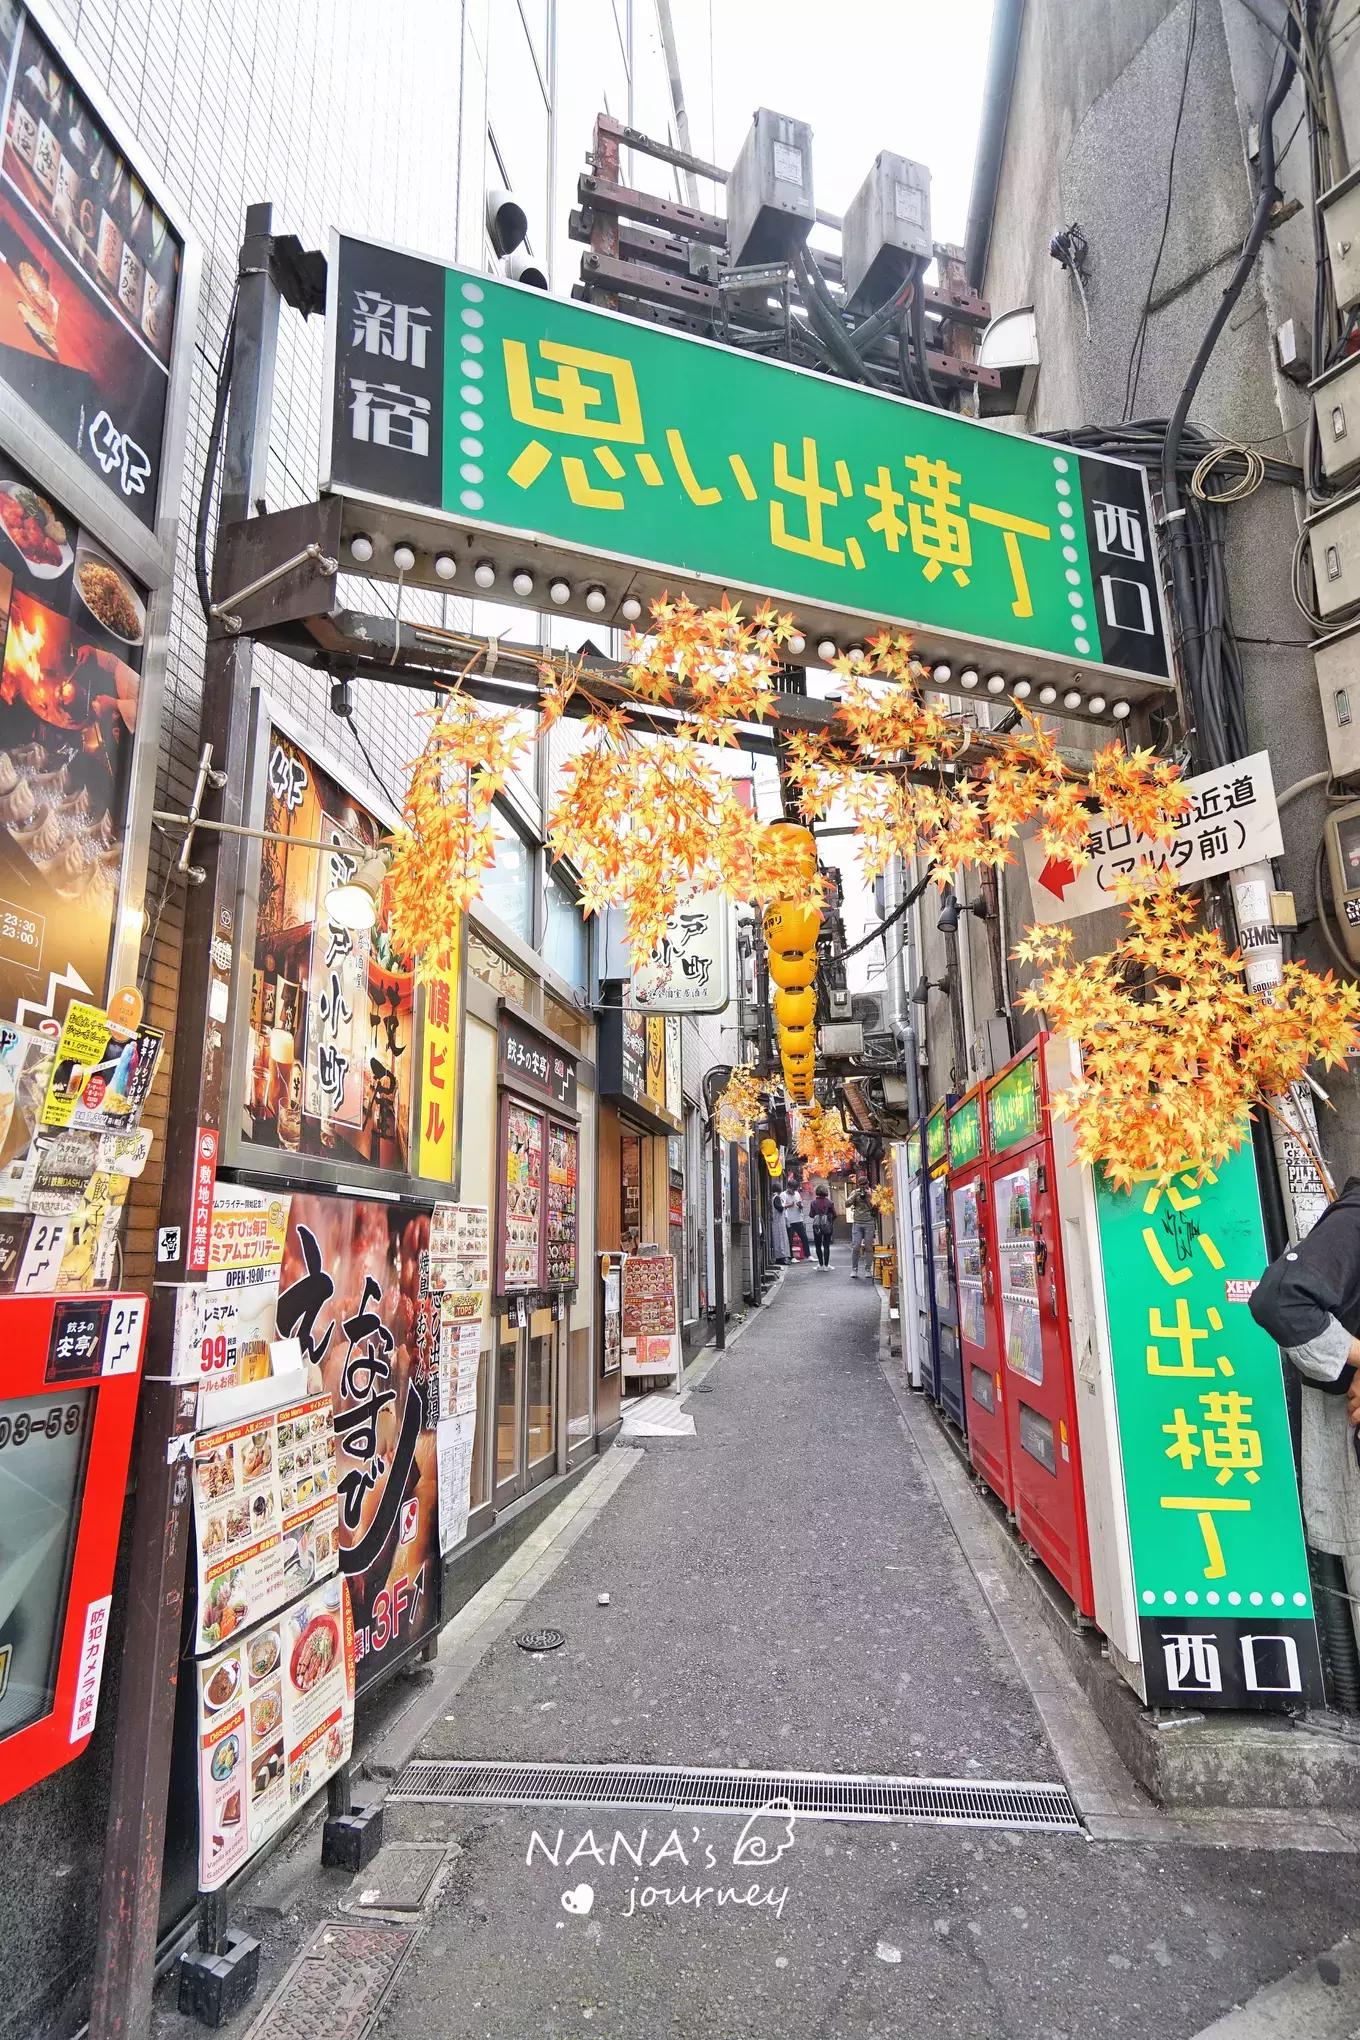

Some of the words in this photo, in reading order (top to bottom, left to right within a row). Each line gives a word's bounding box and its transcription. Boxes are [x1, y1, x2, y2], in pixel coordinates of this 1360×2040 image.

[350, 290, 432, 457] 新宿
[502, 338, 1051, 617] 思い出横丁
[1092, 499, 1155, 636] 西口
[34, 1226, 63, 1251] 2F
[193, 1165, 212, 1266] 敷地内禁煙
[210, 1217, 267, 1239] なすびは毎日
[209, 1239, 281, 1264] ミアムエブリデー
[66, 1321, 95, 1334] 餃子の
[114, 1310, 139, 1334] 2F
[56, 1335, 92, 1358] 安亭
[372, 1576, 409, 1652] 3F
[77, 1608, 106, 1731] 防犯カメラ設置
[1162, 1633, 1303, 1693] 西口
[209, 1712, 241, 1744] Desserts
